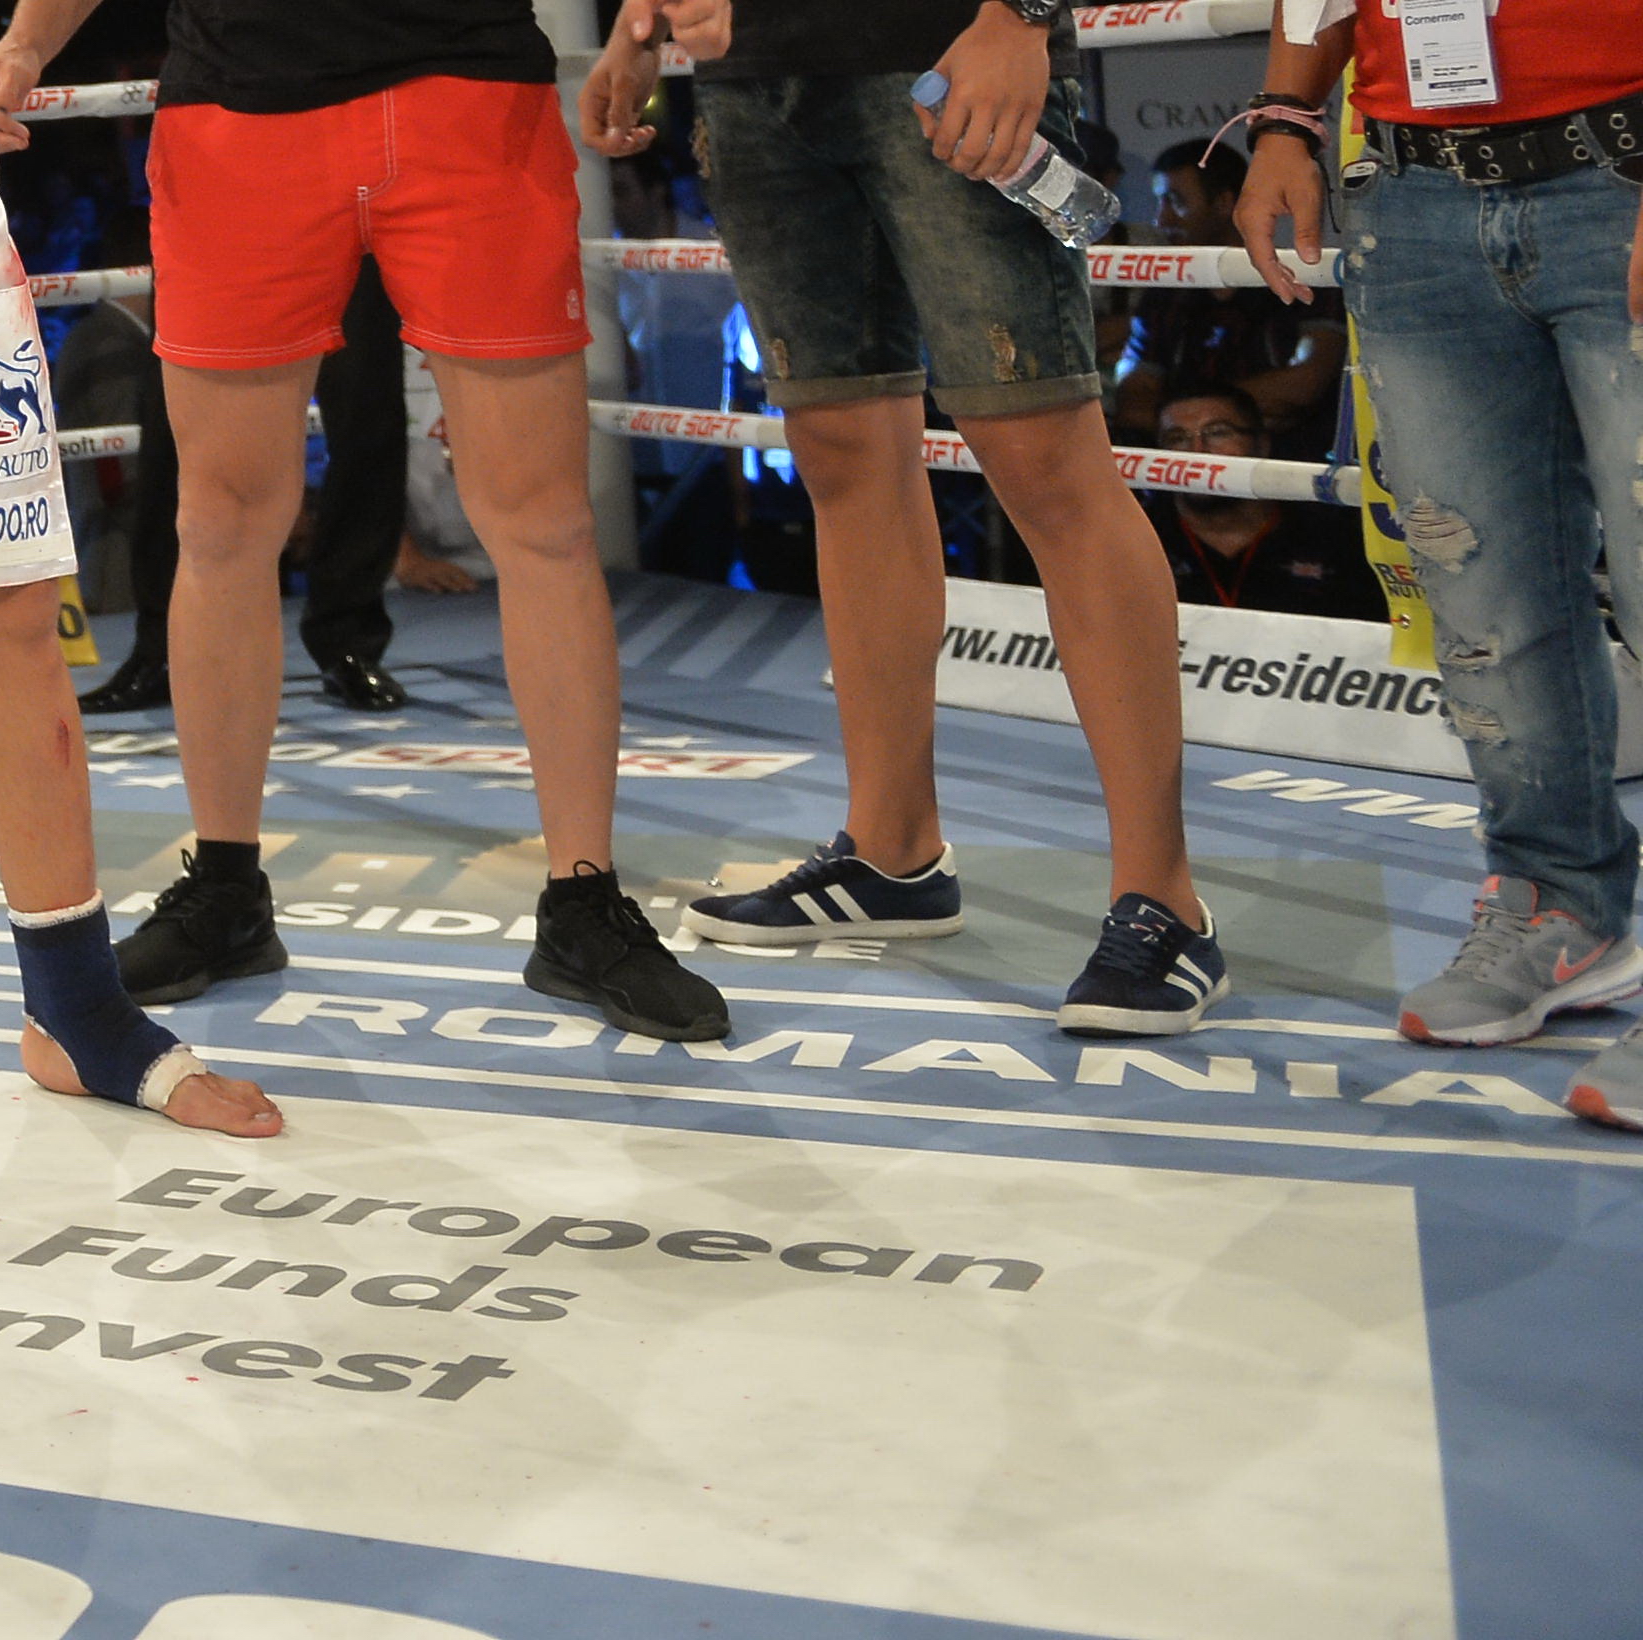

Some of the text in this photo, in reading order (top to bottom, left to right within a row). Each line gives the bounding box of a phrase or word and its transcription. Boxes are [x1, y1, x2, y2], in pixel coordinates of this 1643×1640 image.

[1117, 254, 1194, 280] SOFT
[1146, 456, 1227, 491] SOFT
[256, 990, 1573, 1118] ROMANIA
[7, 1224, 579, 1323] Funds
[118, 1166, 1044, 1292] European
